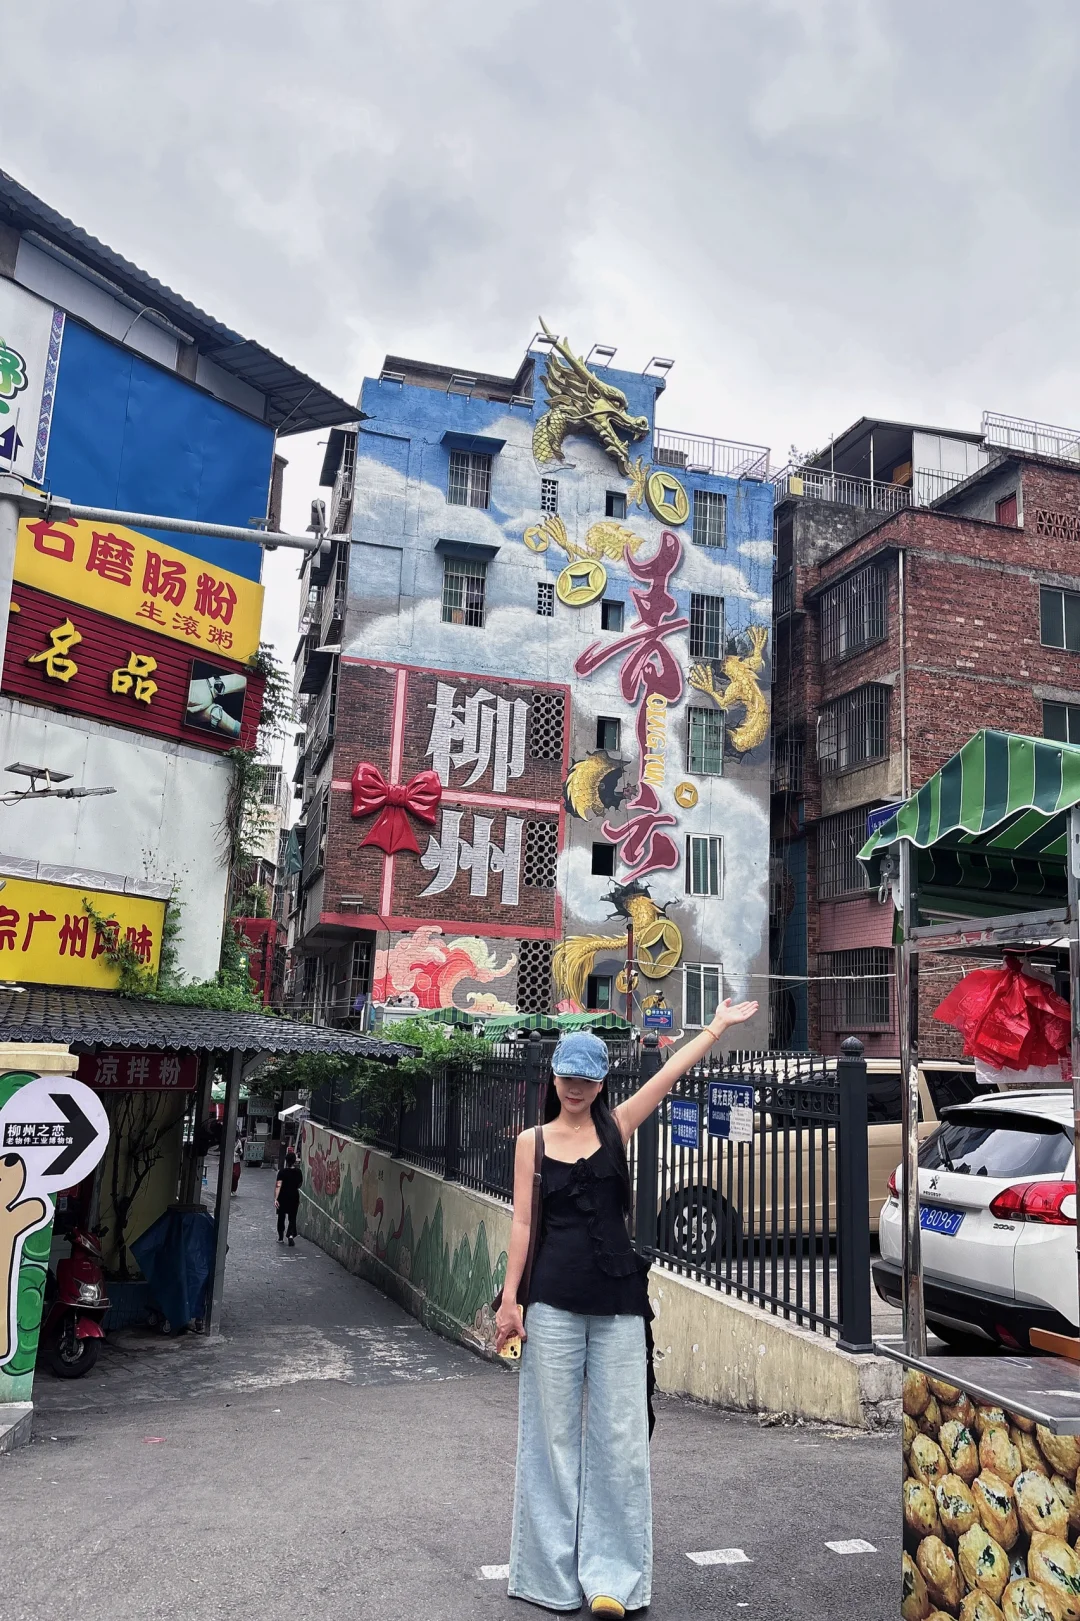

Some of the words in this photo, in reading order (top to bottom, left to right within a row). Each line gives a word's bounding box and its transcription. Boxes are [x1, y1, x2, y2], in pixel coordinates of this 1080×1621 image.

[26, 517, 238, 625] 石磨肠粉
[135, 601, 233, 650] 生滚粥
[418, 680, 530, 905] 柳州
[94, 1055, 182, 1086] 凉拌粉
[7, 1124, 65, 1137] 柳州之恋
